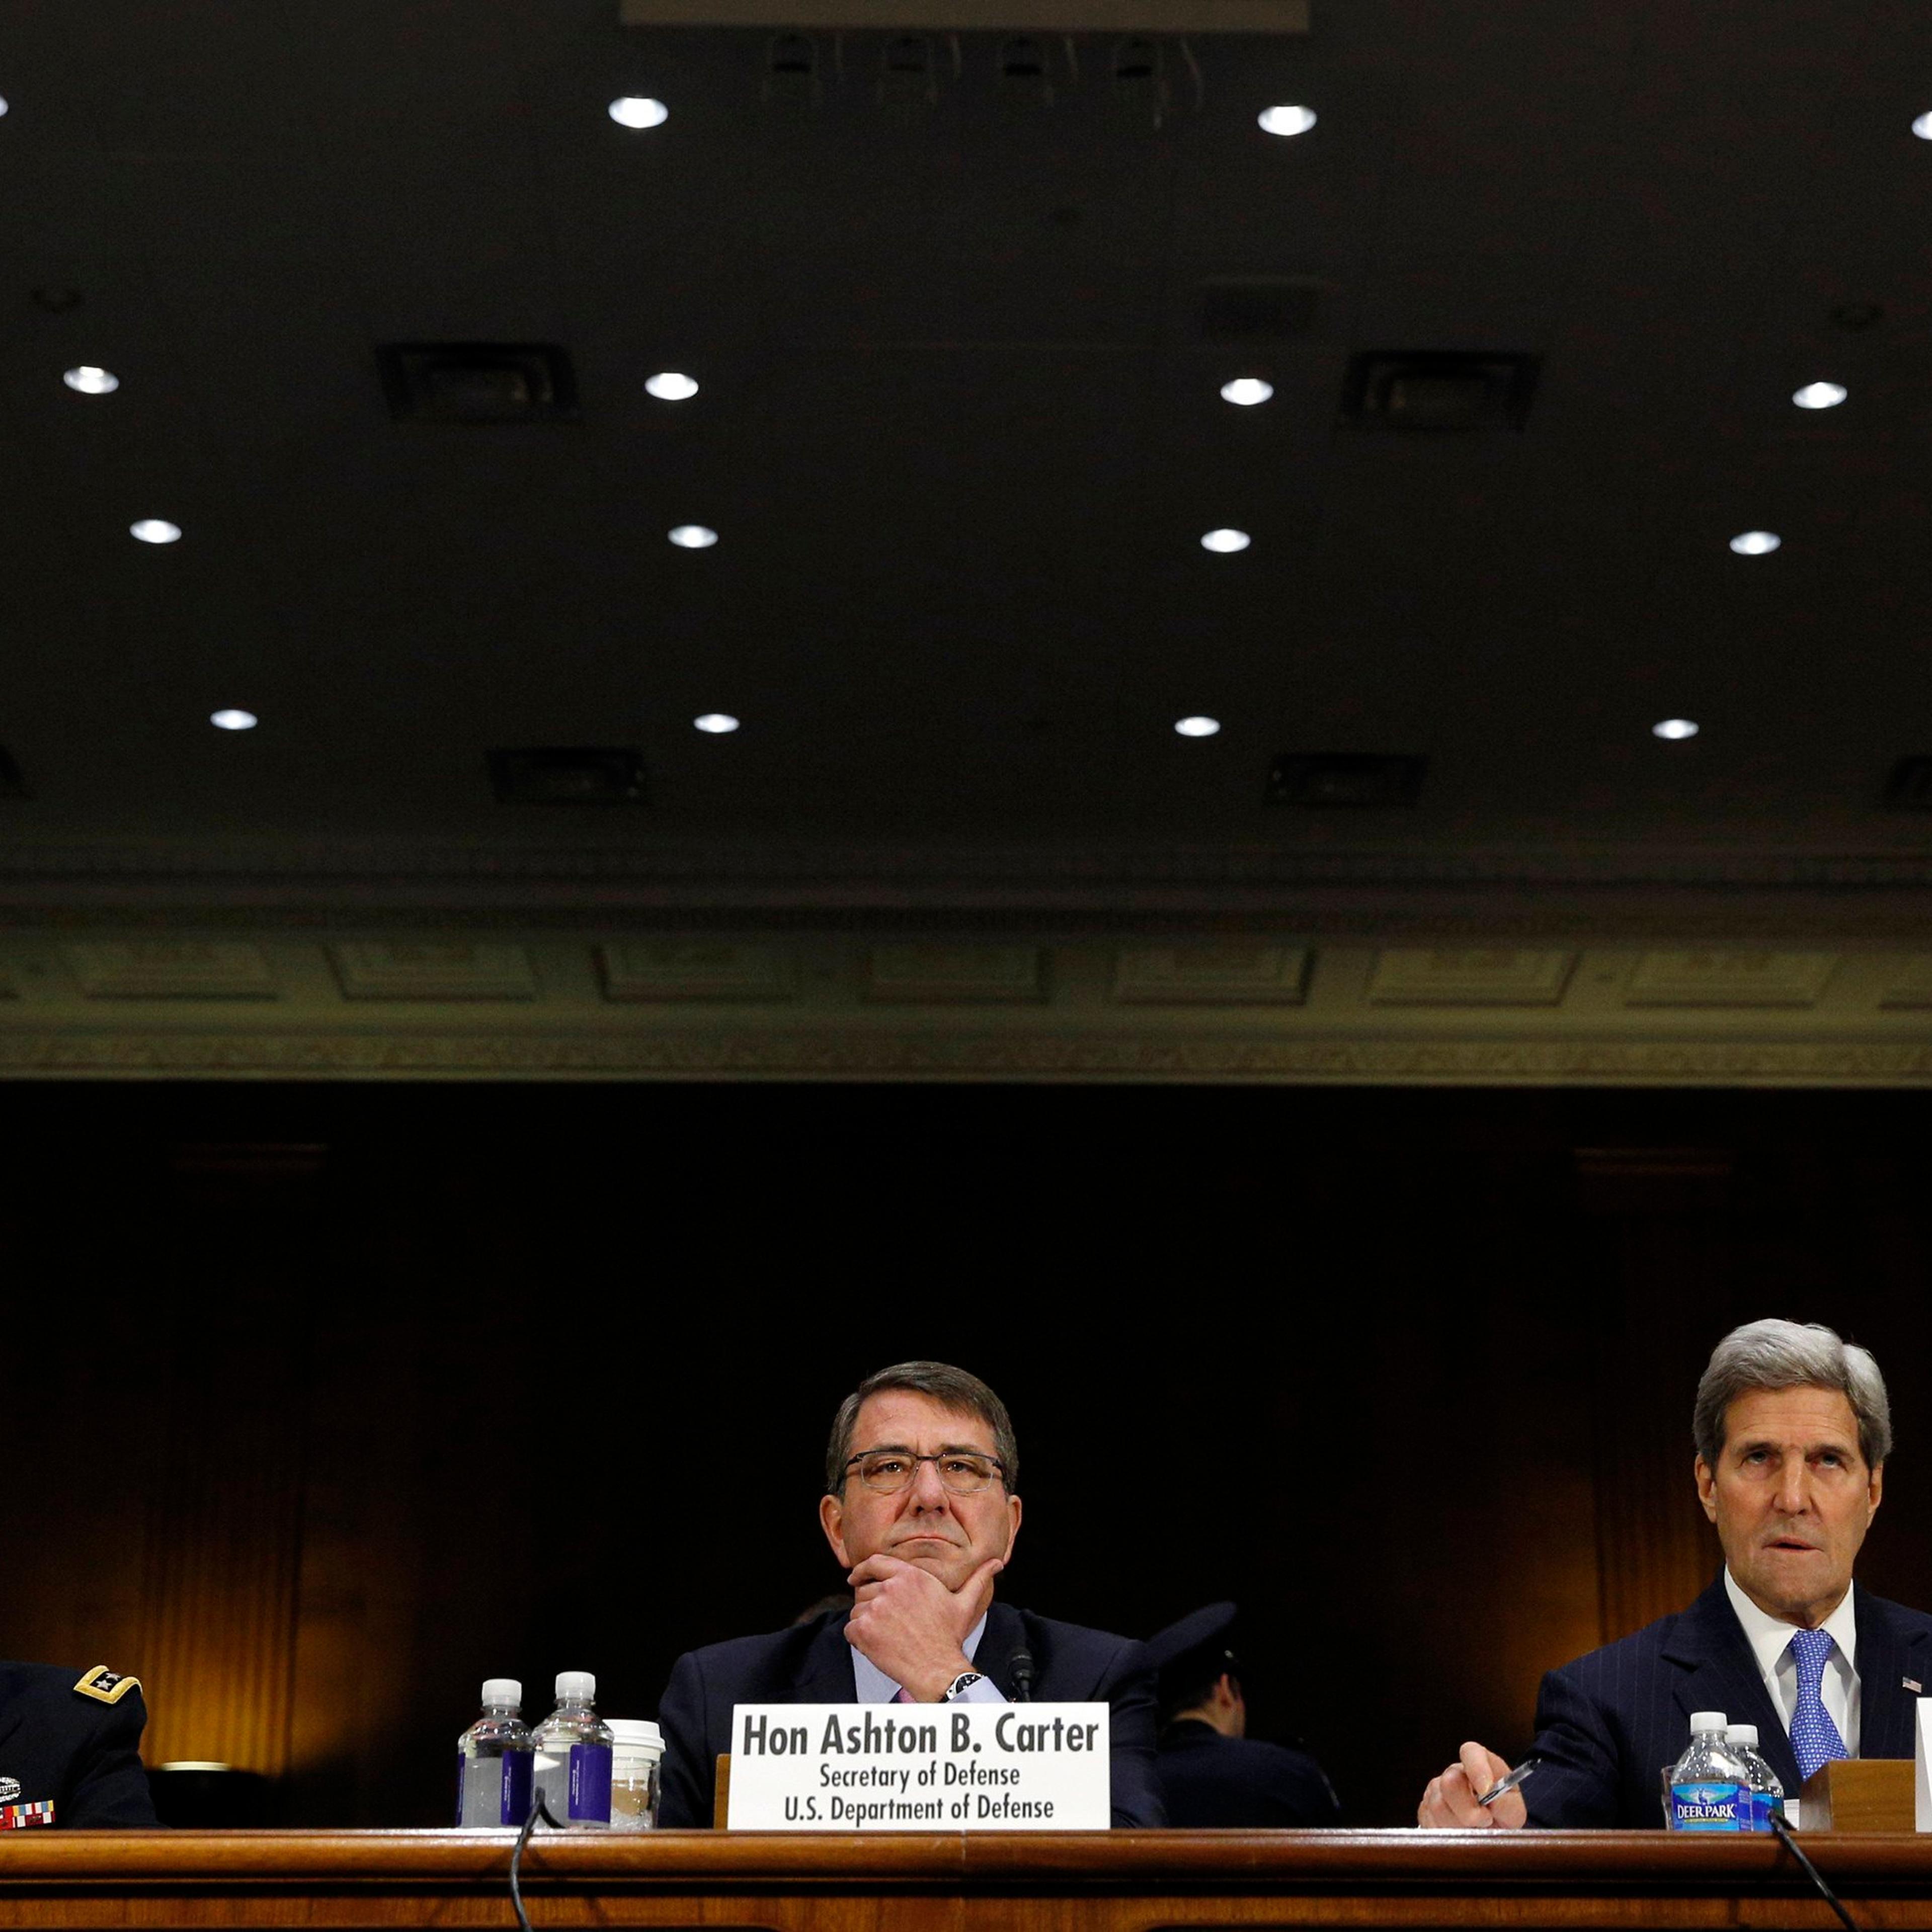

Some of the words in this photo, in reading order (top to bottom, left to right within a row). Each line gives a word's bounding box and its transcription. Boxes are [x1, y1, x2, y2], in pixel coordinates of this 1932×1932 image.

[744, 1715, 808, 1755] Hon
[820, 1712, 936, 1754] Ashton
[951, 1713, 982, 1753] B.
[995, 1712, 1098, 1752] Carter
[820, 1763, 910, 1794] Secretary
[918, 1760, 936, 1786] of
[944, 1760, 1020, 1786] Defense
[785, 1796, 823, 1821] U.S.
[831, 1796, 943, 1828] Department
[951, 1793, 970, 1819] of
[978, 1793, 1054, 1818] Defense
[1677, 1804, 1705, 1819] DEER
[1705, 1803, 1736, 1818] PARK
